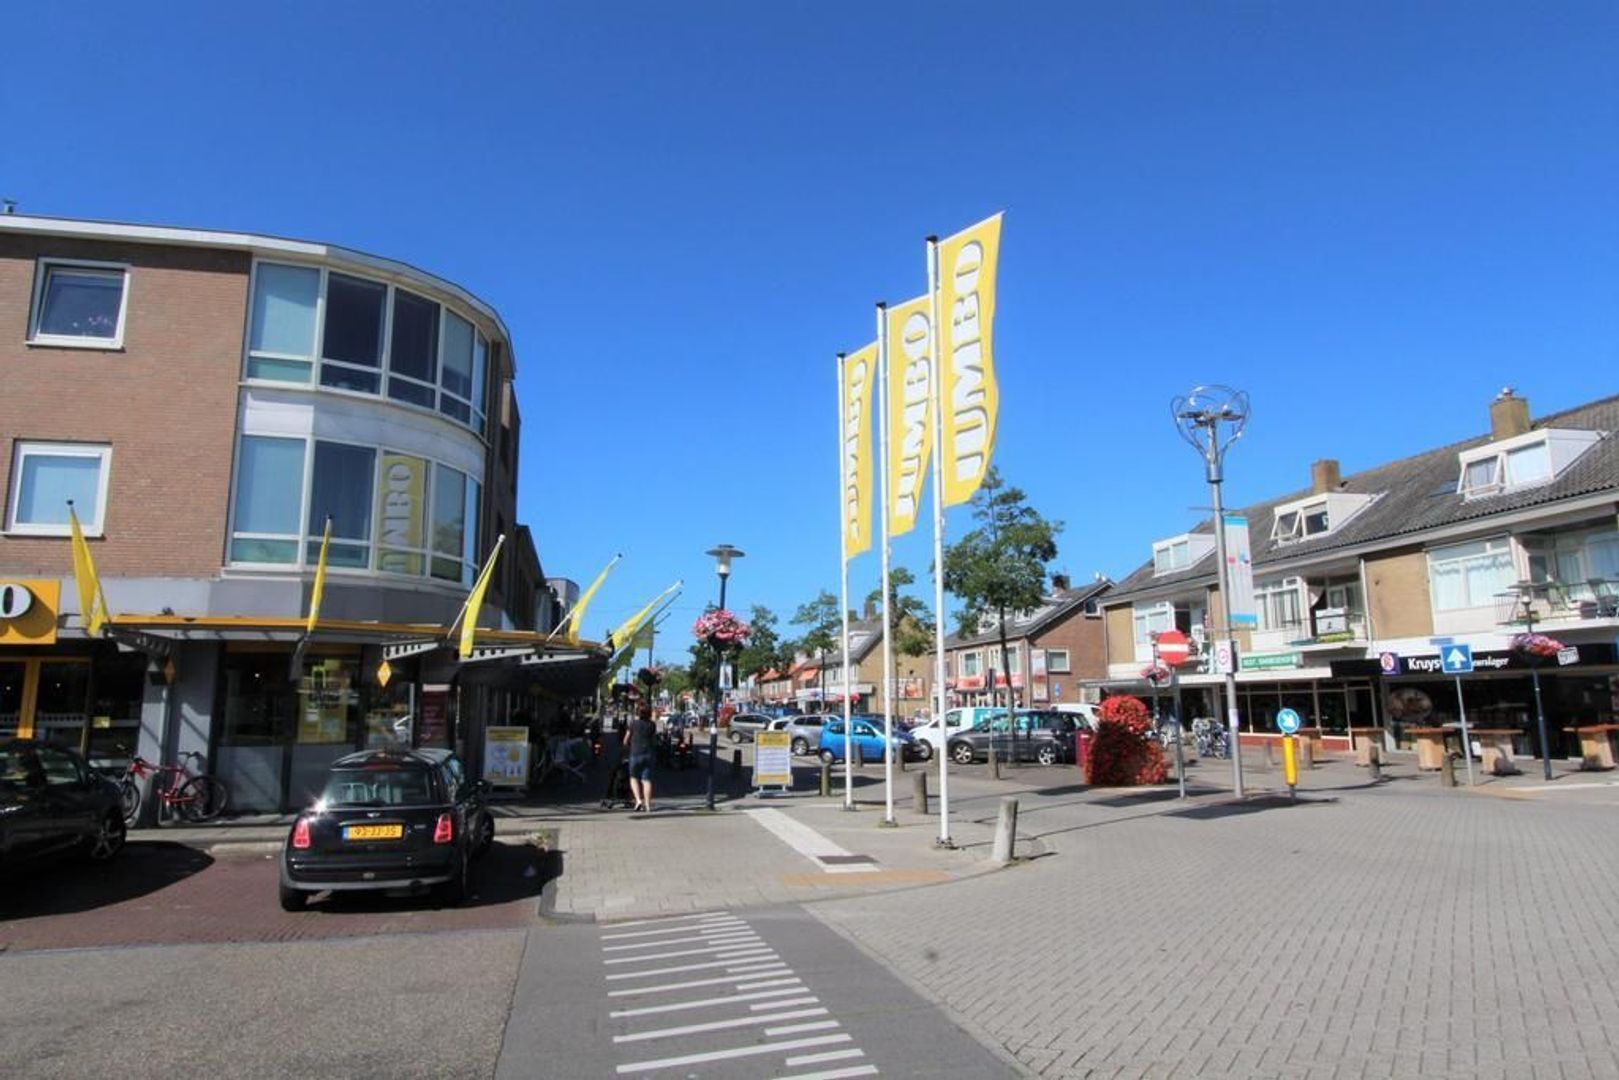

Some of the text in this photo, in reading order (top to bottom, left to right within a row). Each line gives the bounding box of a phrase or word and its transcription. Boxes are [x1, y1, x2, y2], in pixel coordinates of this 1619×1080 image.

[847, 359, 867, 540] JUMBO
[895, 310, 931, 517] JUMBO
[952, 240, 988, 483] JUMBO
[1408, 657, 1441, 672] Kruys
